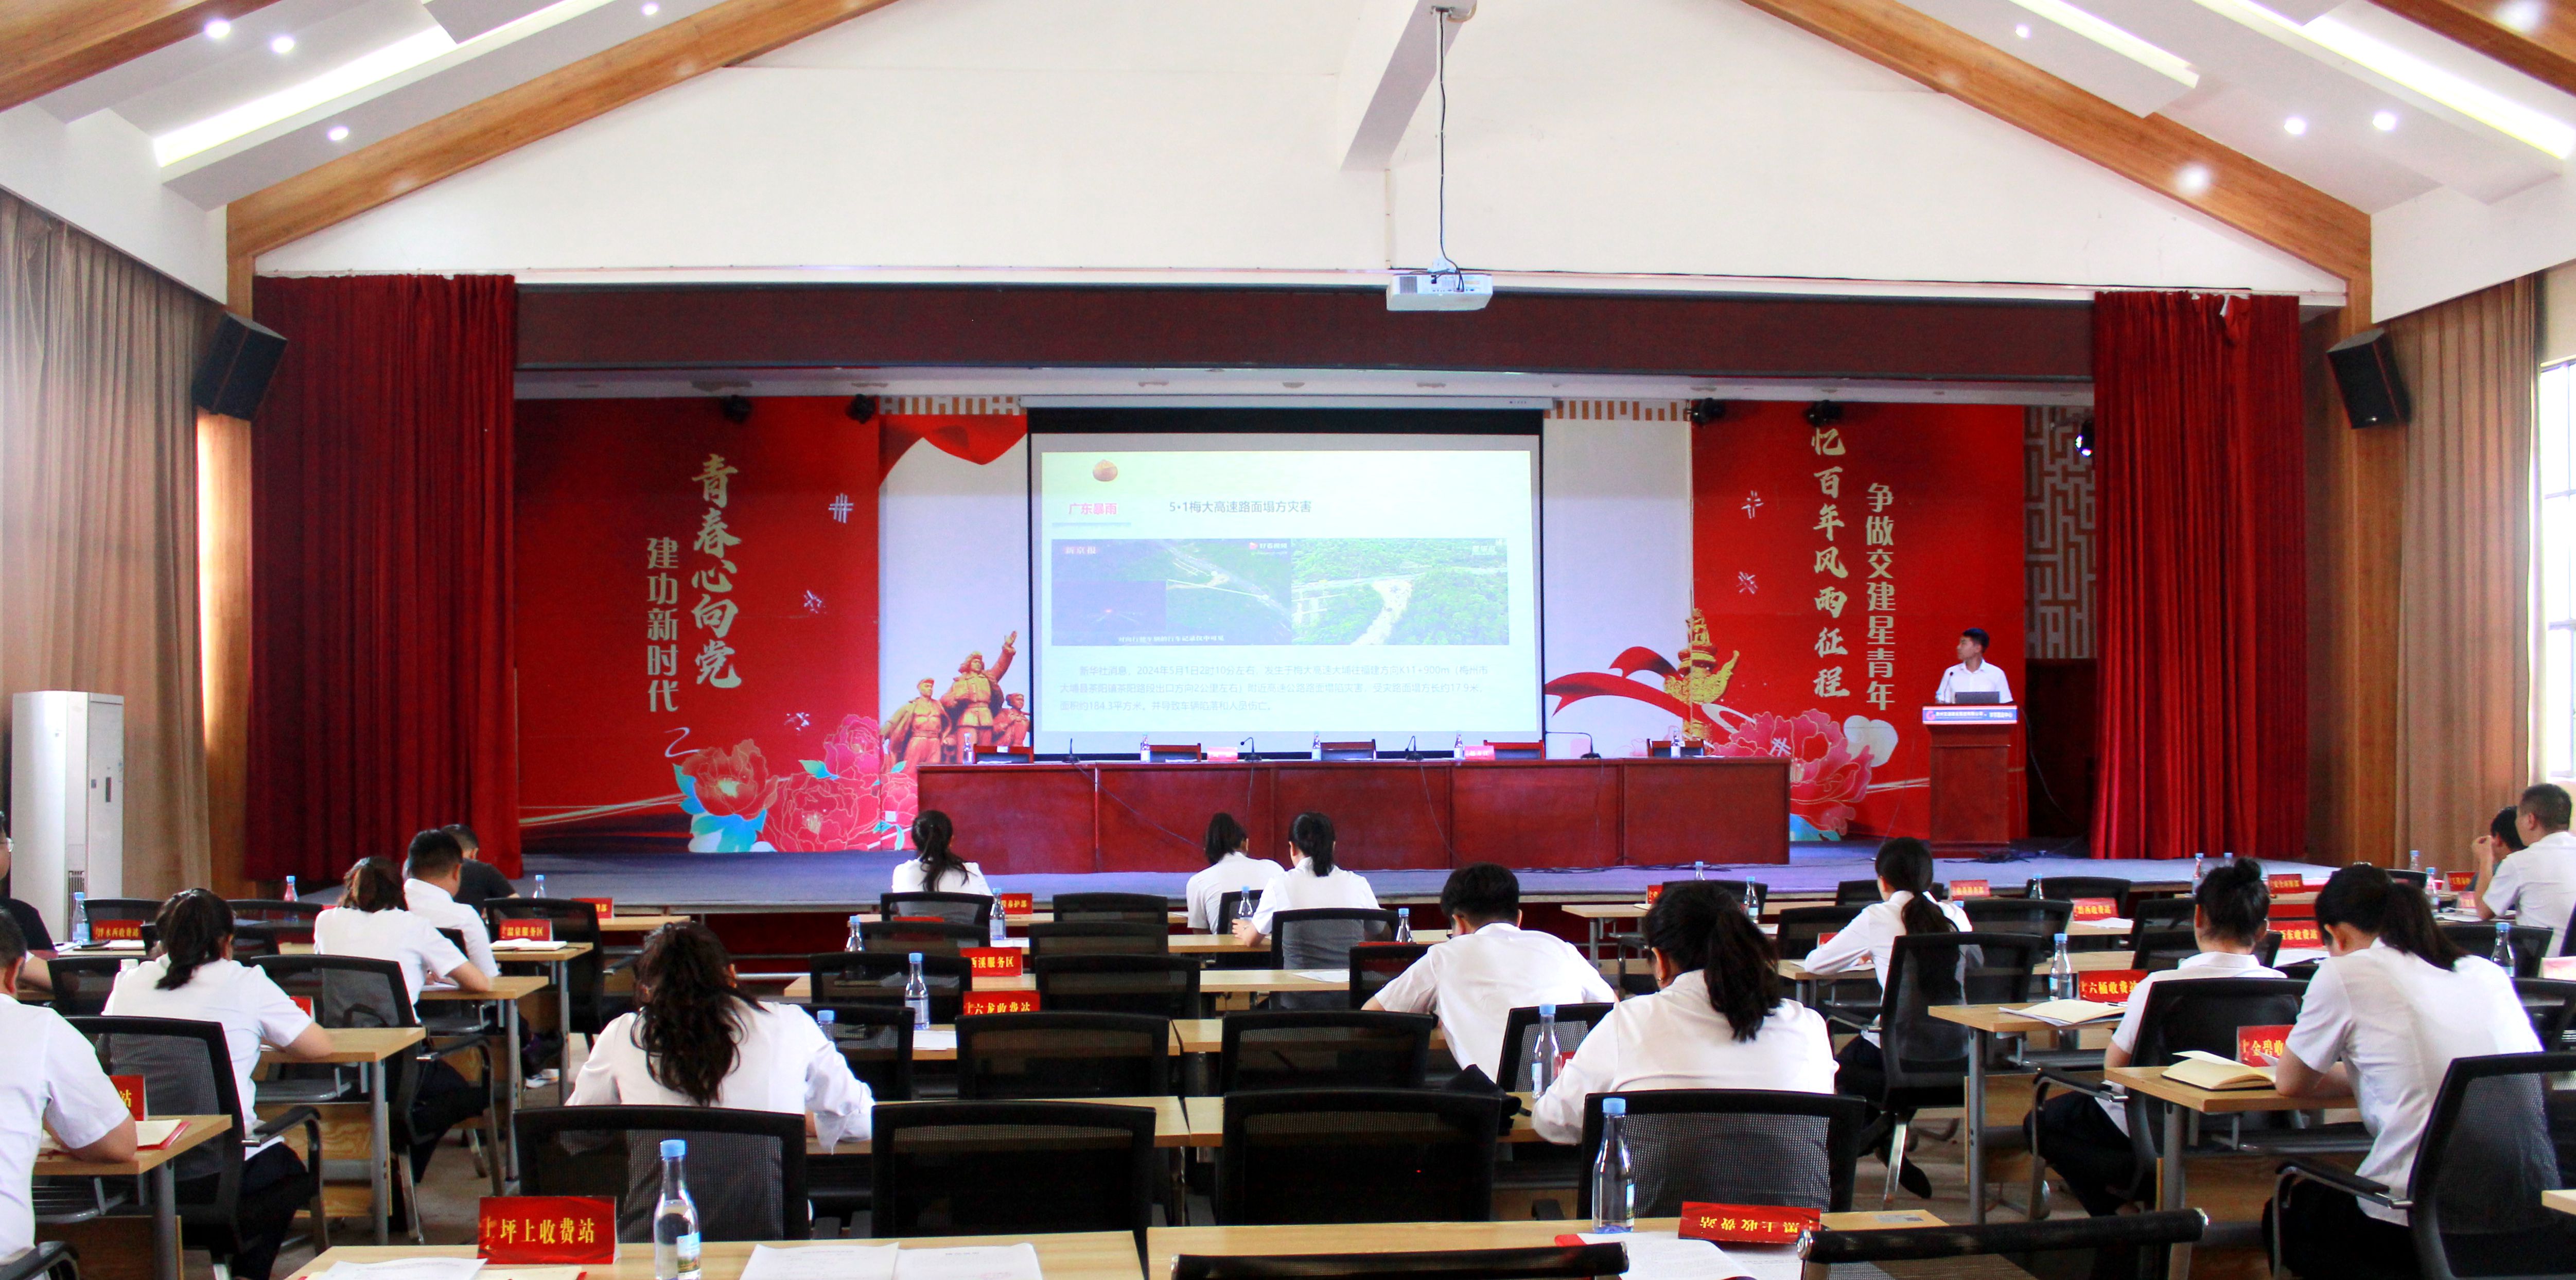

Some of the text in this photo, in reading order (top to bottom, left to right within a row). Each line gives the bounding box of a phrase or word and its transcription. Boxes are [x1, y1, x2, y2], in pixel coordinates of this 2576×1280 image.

[691, 453, 742, 689] 青春心向党
[1065, 546, 1096, 554] 新京报
[1068, 502, 1117, 515] 广东暴雨
[1811, 428, 1851, 698] 忆百年风雨征程
[1866, 482, 1896, 711] 争做交建星青年
[646, 536, 679, 712] 建功新时代
[500, 1217, 595, 1244] 坪上收费站
